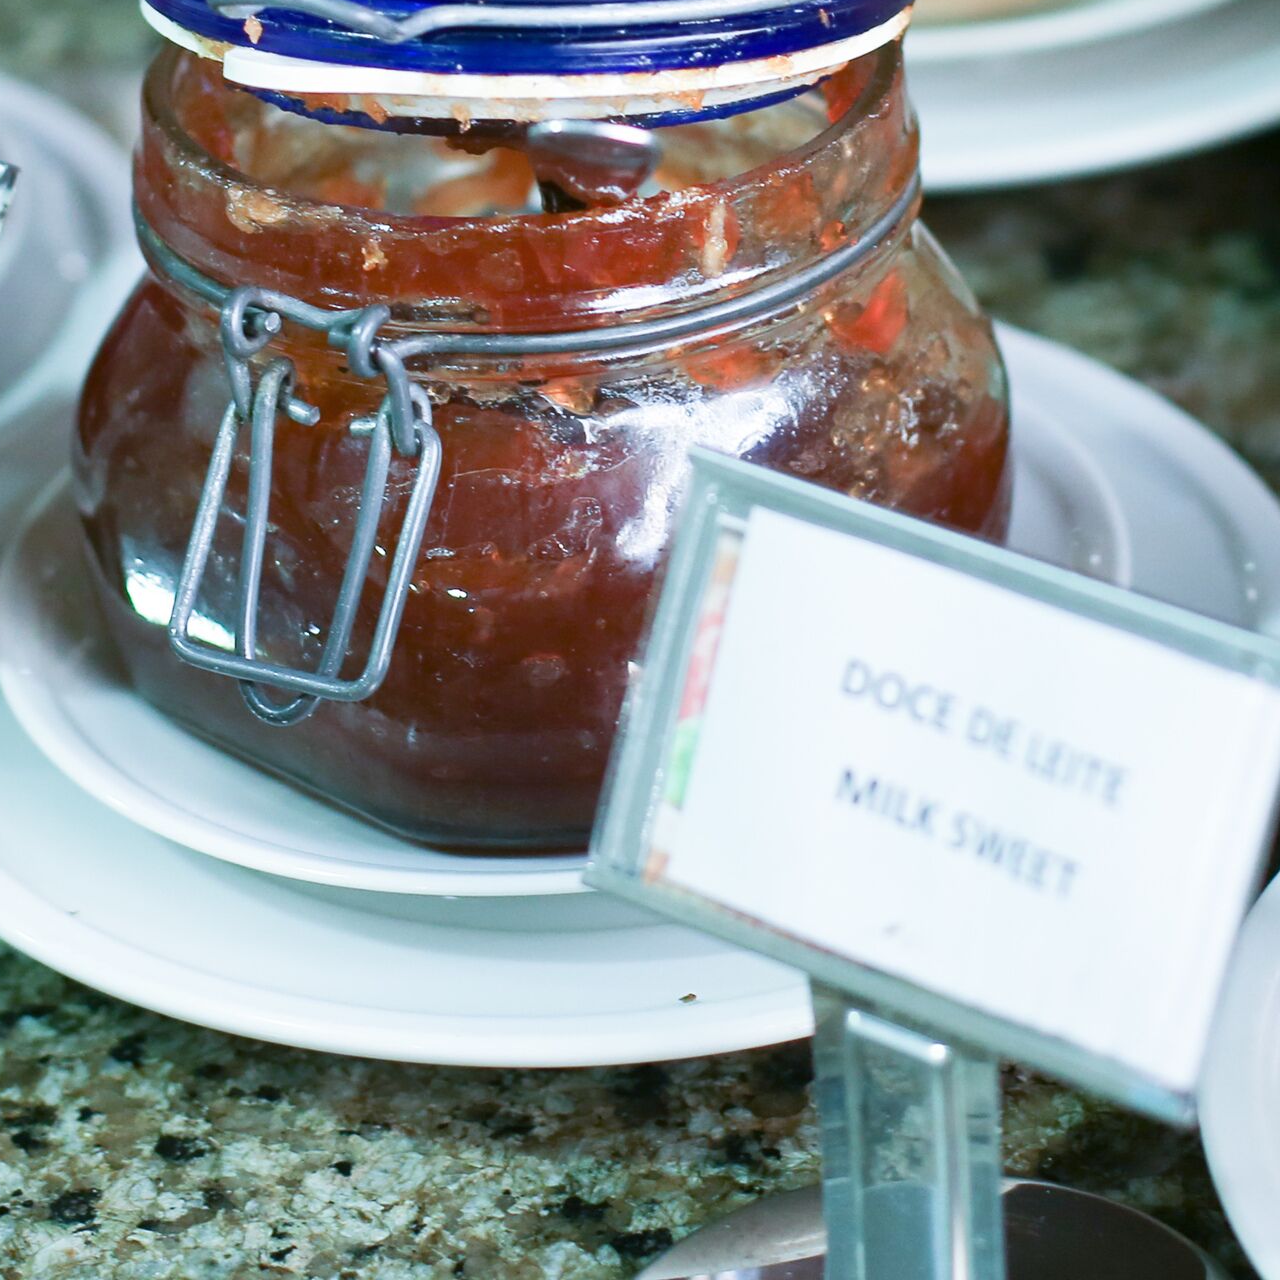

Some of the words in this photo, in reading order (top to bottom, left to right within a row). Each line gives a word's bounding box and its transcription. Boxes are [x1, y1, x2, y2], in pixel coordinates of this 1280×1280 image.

[842, 659, 955, 730] DOCE
[968, 707, 1018, 759] DE
[1027, 733, 1127, 808] LEITE
[834, 766, 942, 837] MILK
[950, 813, 1080, 897] SWEET
